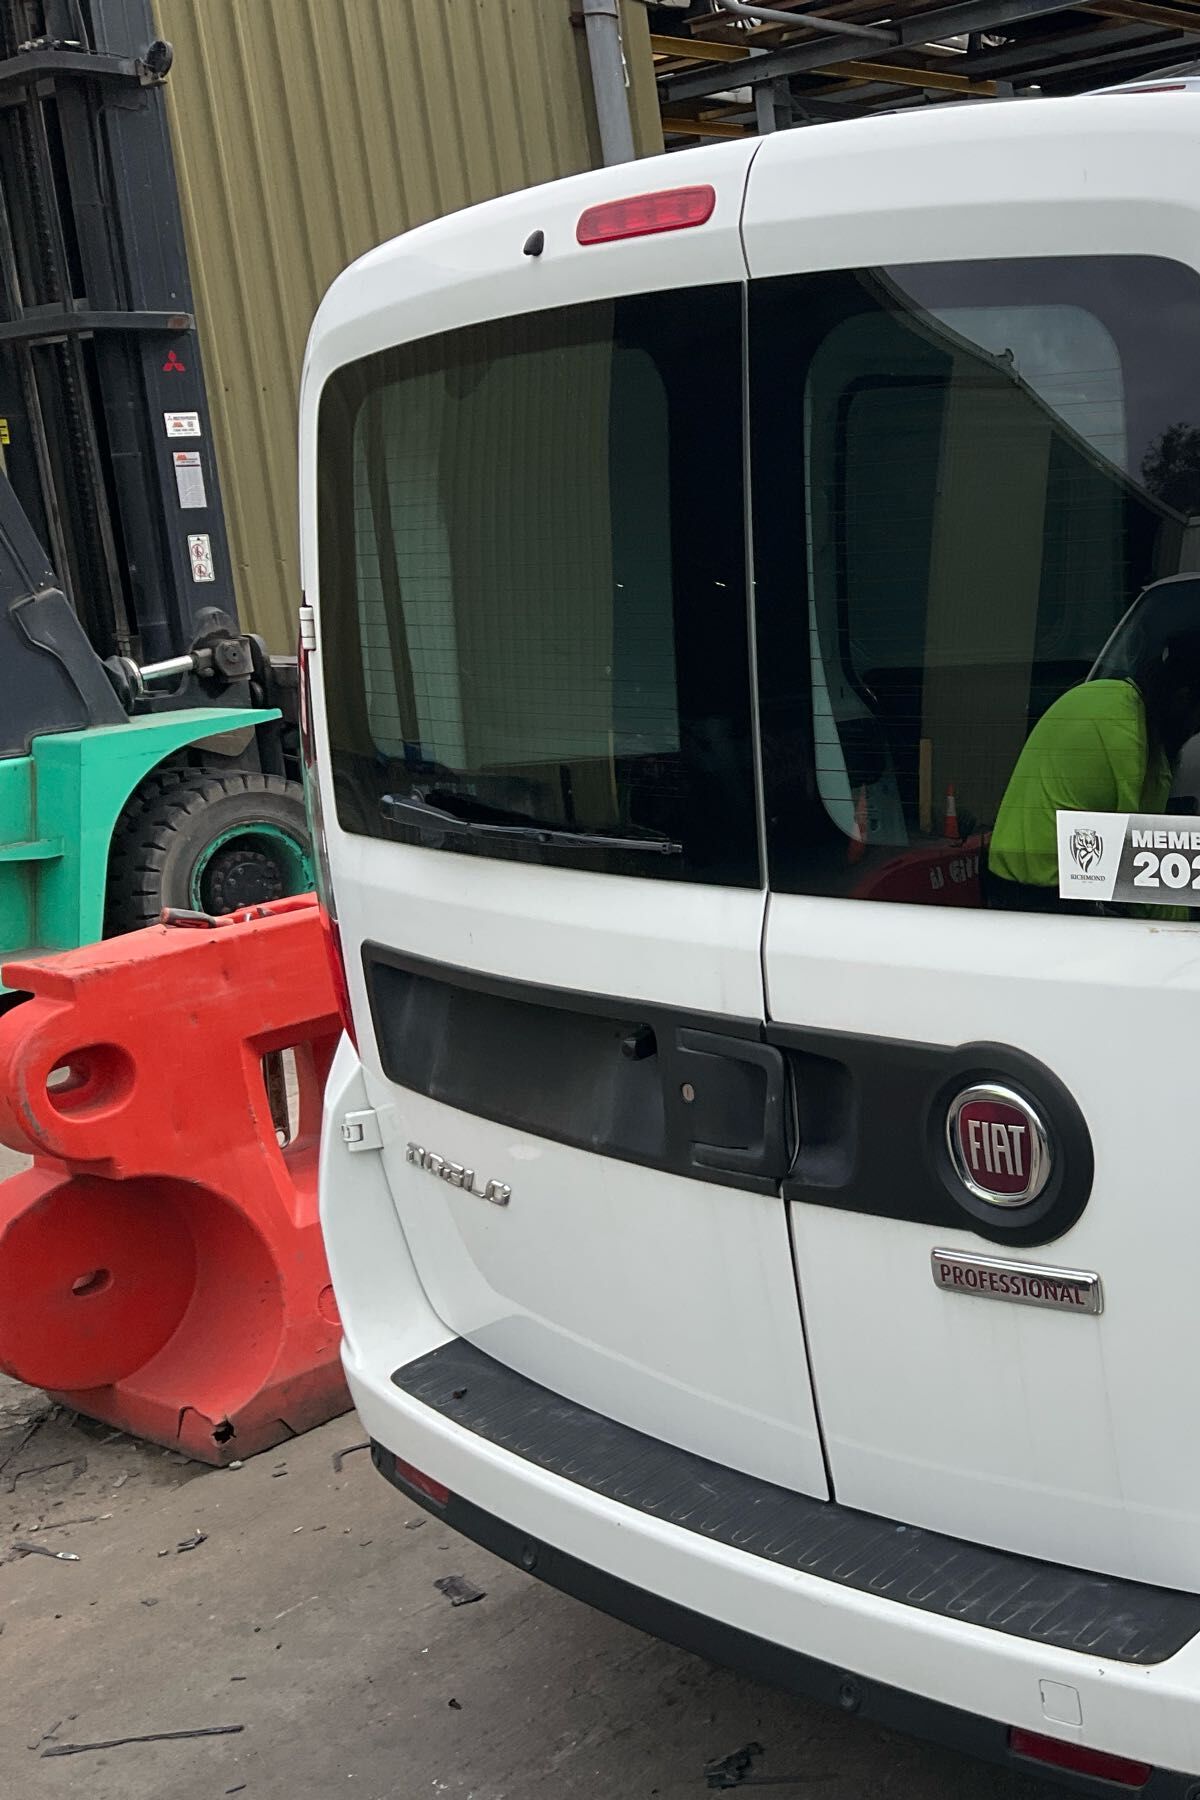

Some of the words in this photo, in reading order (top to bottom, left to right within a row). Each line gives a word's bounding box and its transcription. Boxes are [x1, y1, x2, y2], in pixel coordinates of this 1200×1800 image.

[1070, 873, 1106, 882] RICHMOND
[967, 1119, 1026, 1177] FIAT
[939, 1263, 1086, 1306] PROFESSIONAL
